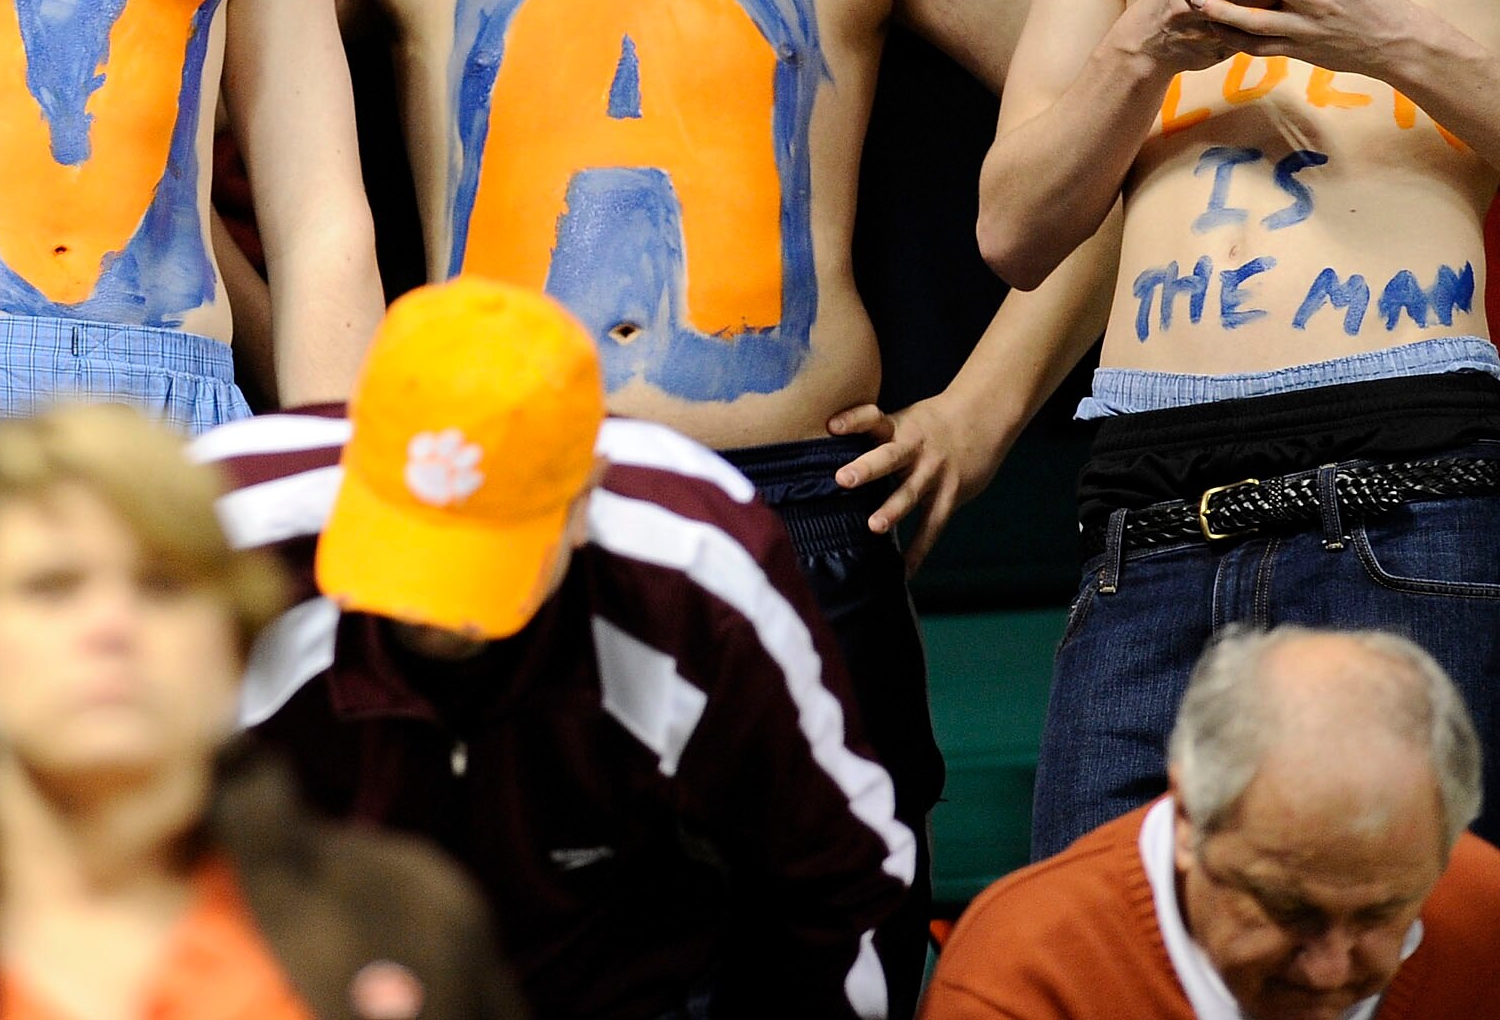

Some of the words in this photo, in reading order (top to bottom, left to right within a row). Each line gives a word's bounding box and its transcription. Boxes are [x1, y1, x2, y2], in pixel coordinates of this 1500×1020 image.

[1191, 146, 1328, 235] IS
[1132, 255, 1277, 342] THE
[1292, 260, 1475, 337] MAN
